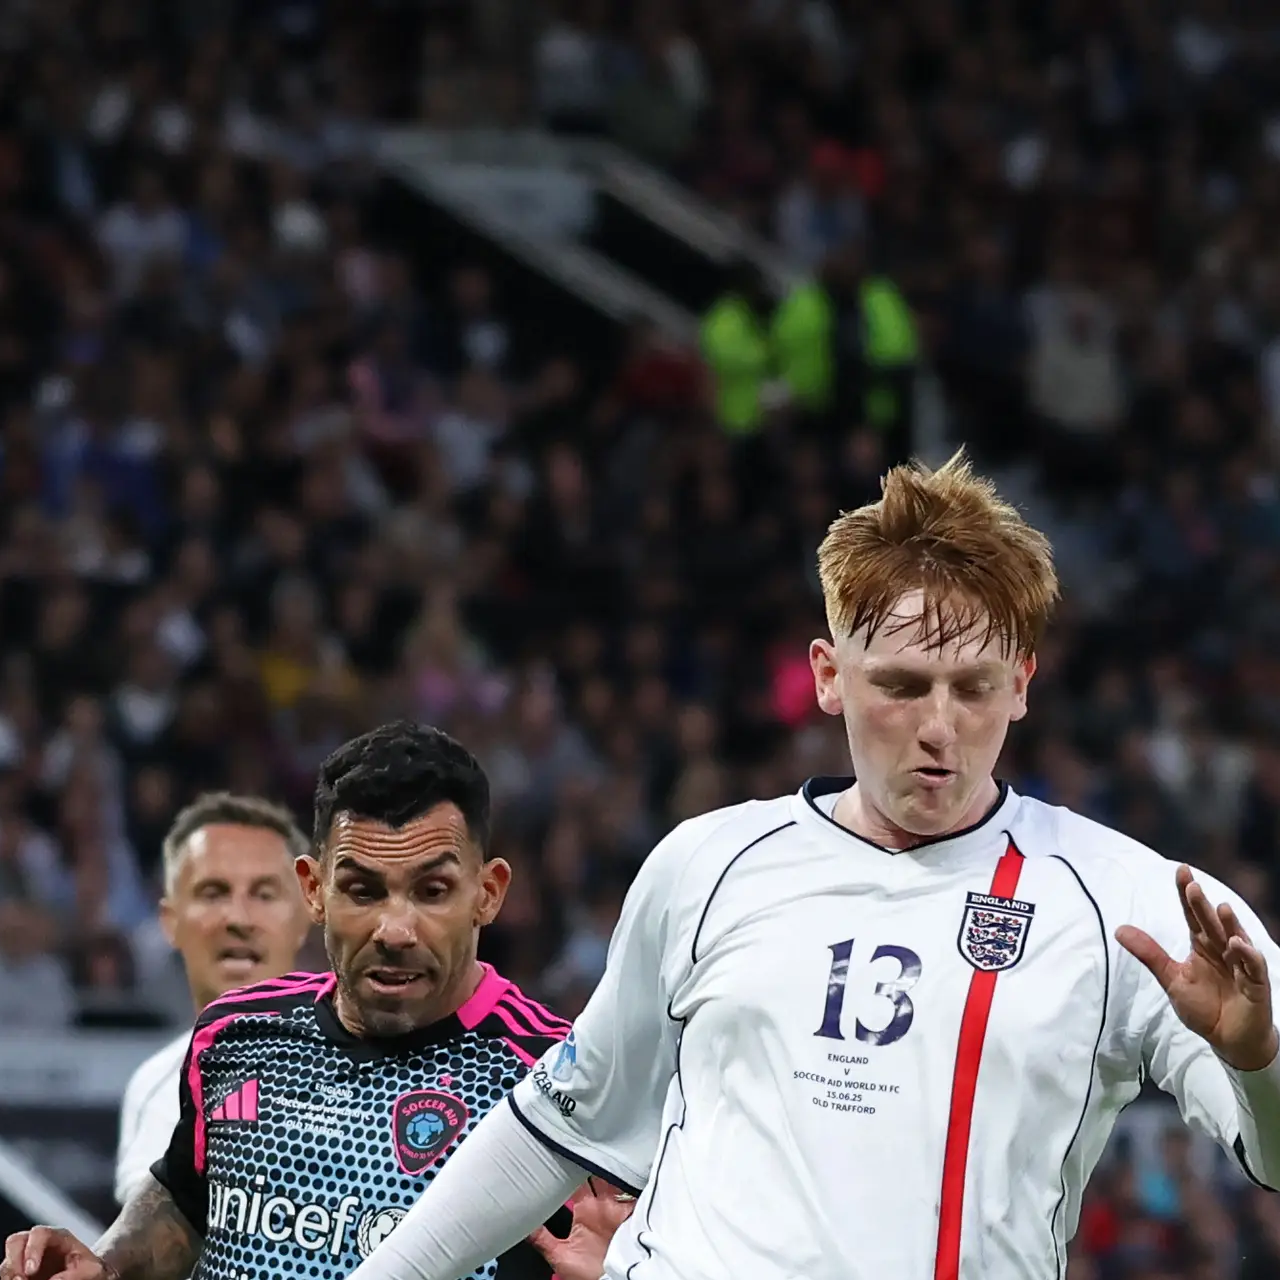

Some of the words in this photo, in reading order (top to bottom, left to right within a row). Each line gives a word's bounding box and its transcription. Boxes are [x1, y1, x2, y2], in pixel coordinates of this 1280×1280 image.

[970, 894, 1030, 911] ENGLAND
[813, 938, 923, 1046] 13
[827, 1053, 869, 1065] ENGLAND
[844, 1068, 851, 1076] V
[793, 1071, 826, 1083] SOCCER
[827, 1078, 842, 1087] AID
[844, 1081, 876, 1091] WORLD
[878, 1084, 887, 1092] XI
[889, 1085, 900, 1094] FC
[551, 1090, 577, 1113] AID
[812, 1097, 829, 1108] OLD
[831, 1102, 876, 1115] TRAFFORD
[826, 1090, 863, 1102] 15.06.25
[402, 1099, 447, 1116] SOCCER
[444, 1108, 459, 1127] AID
[208, 1174, 361, 1256] unicef
